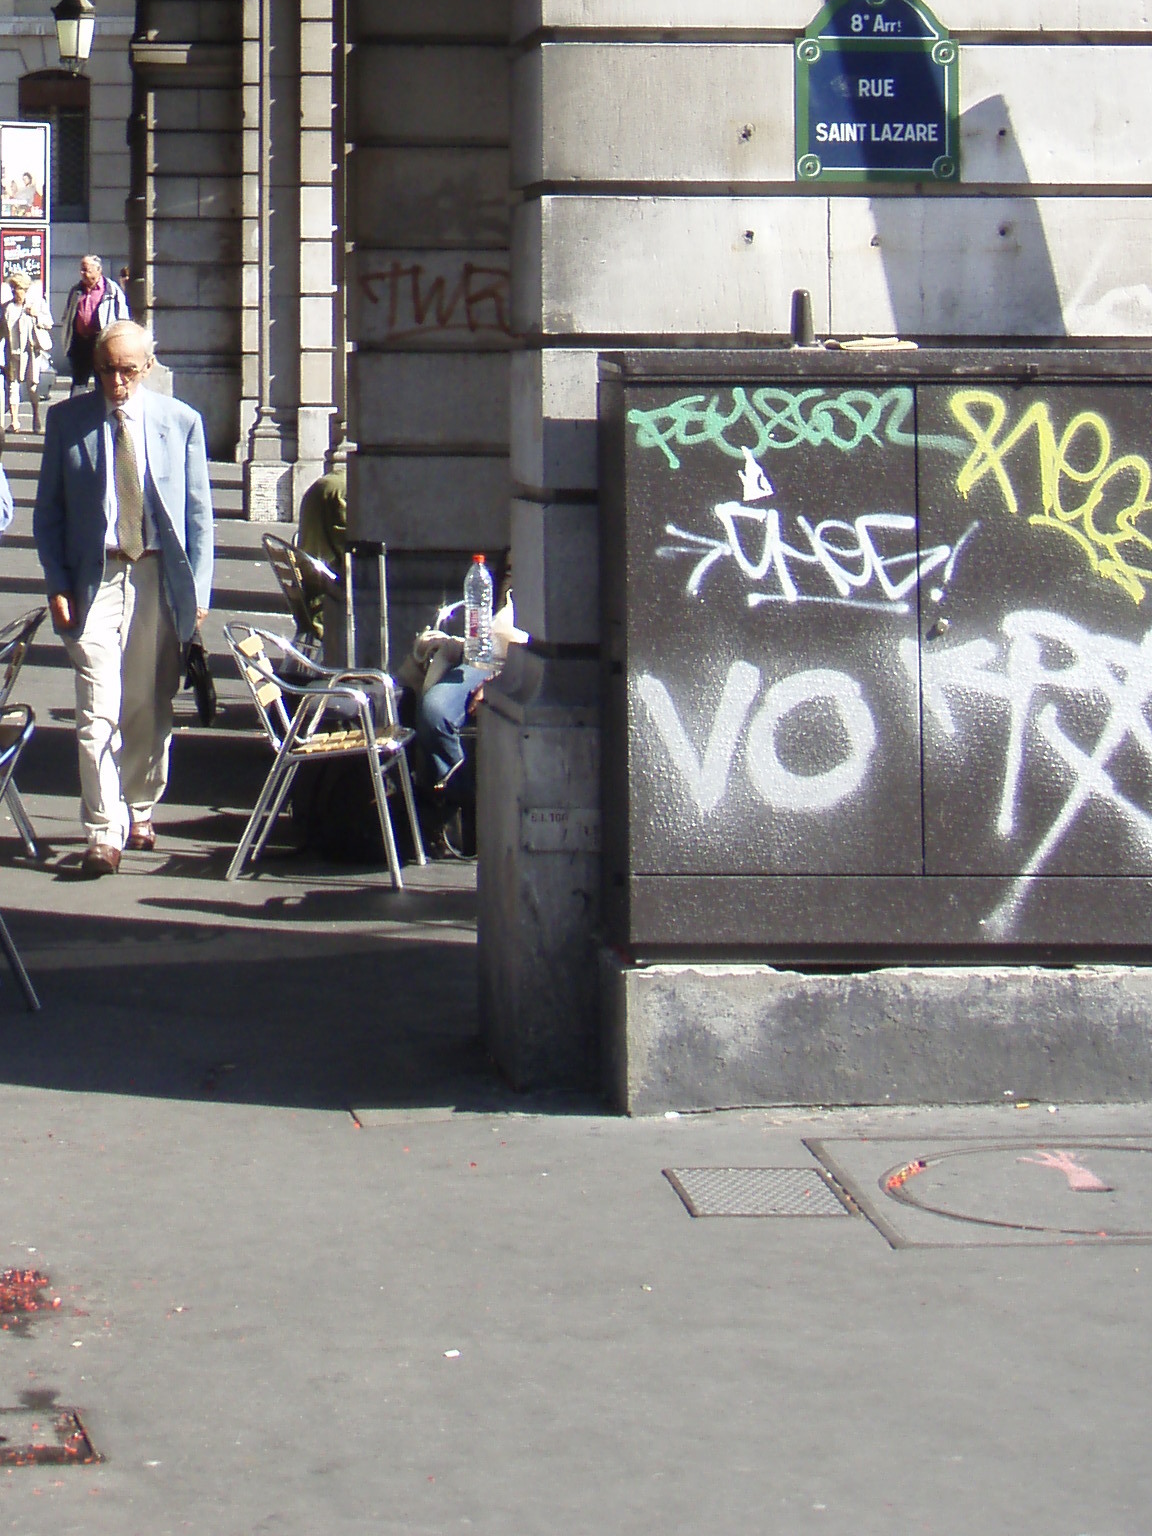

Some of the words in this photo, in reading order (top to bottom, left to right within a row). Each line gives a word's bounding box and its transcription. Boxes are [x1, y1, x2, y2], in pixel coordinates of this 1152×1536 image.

[858, 79, 895, 97] RUE
[815, 123, 867, 142] SAINT
[870, 123, 939, 142] LAZARE
